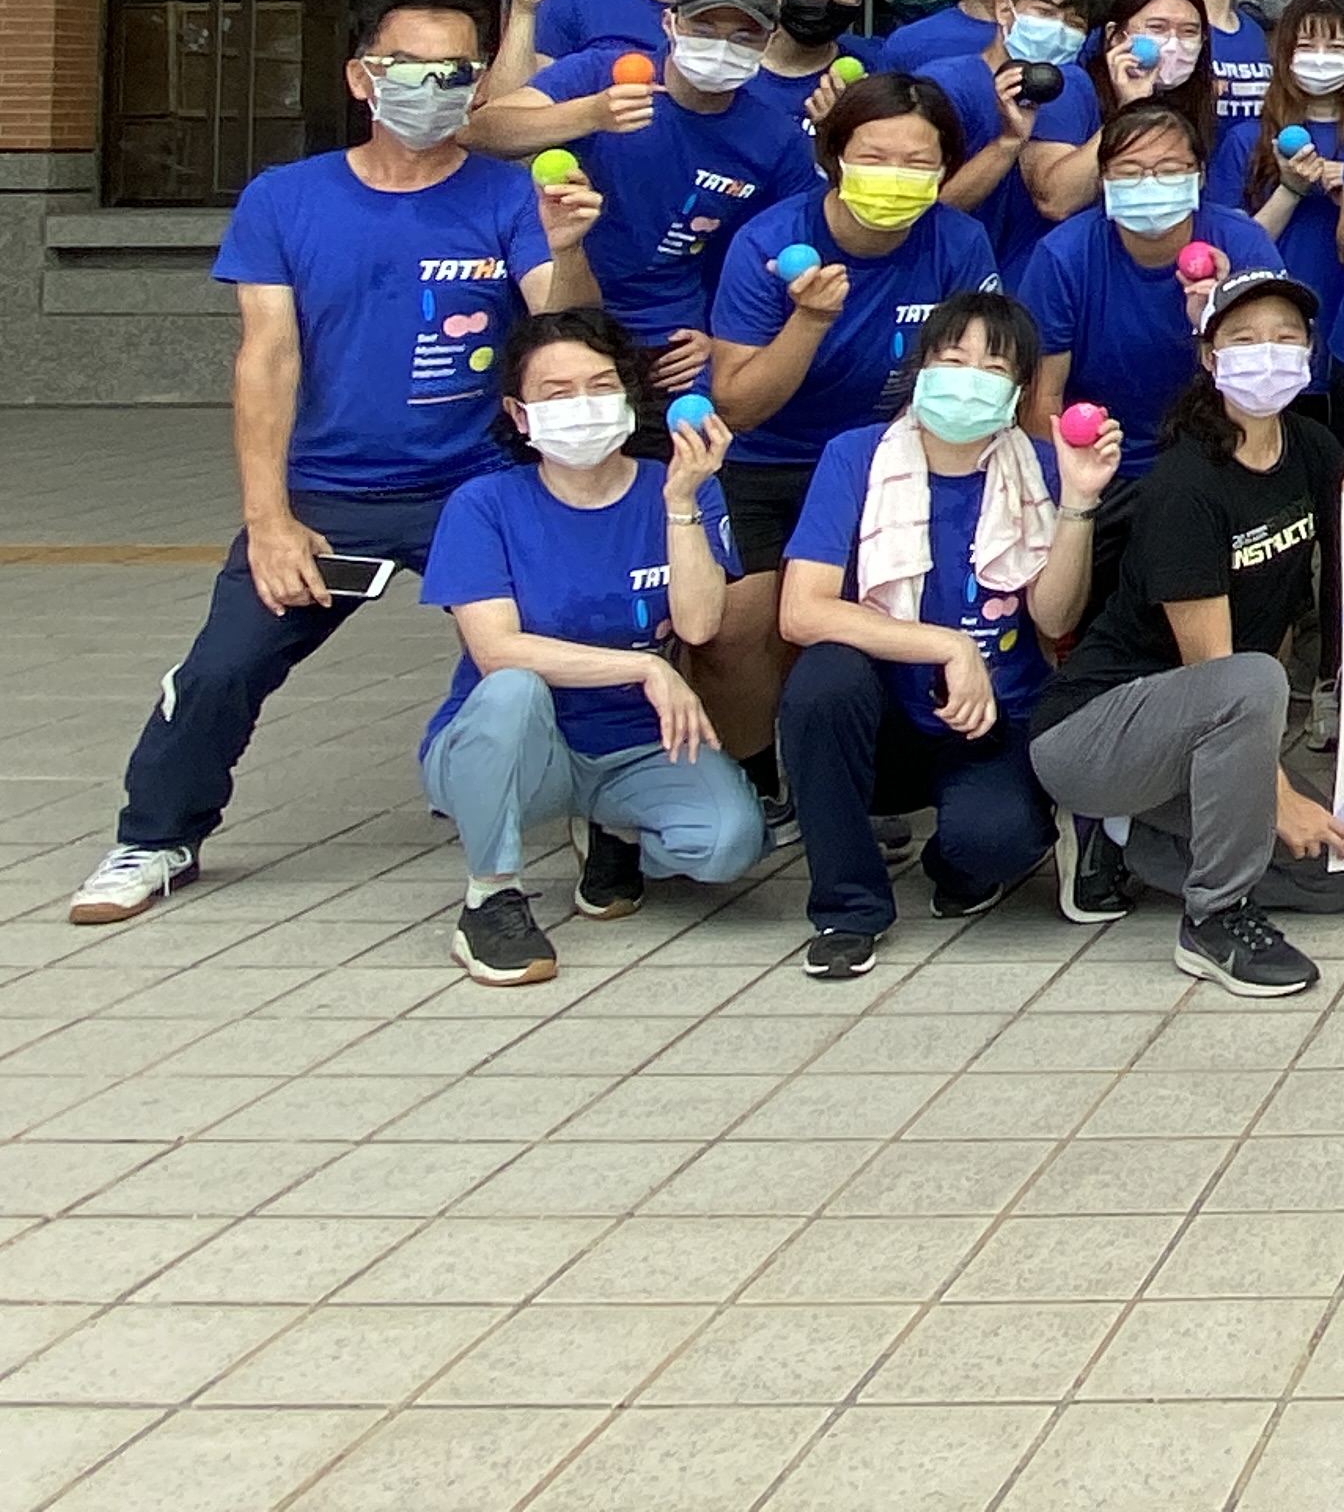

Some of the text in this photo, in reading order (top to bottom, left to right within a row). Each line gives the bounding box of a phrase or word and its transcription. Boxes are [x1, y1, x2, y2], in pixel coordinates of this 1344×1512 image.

[695, 168, 757, 199] TATHA
[896, 303, 937, 324] TAT
[629, 563, 670, 591] TAT
